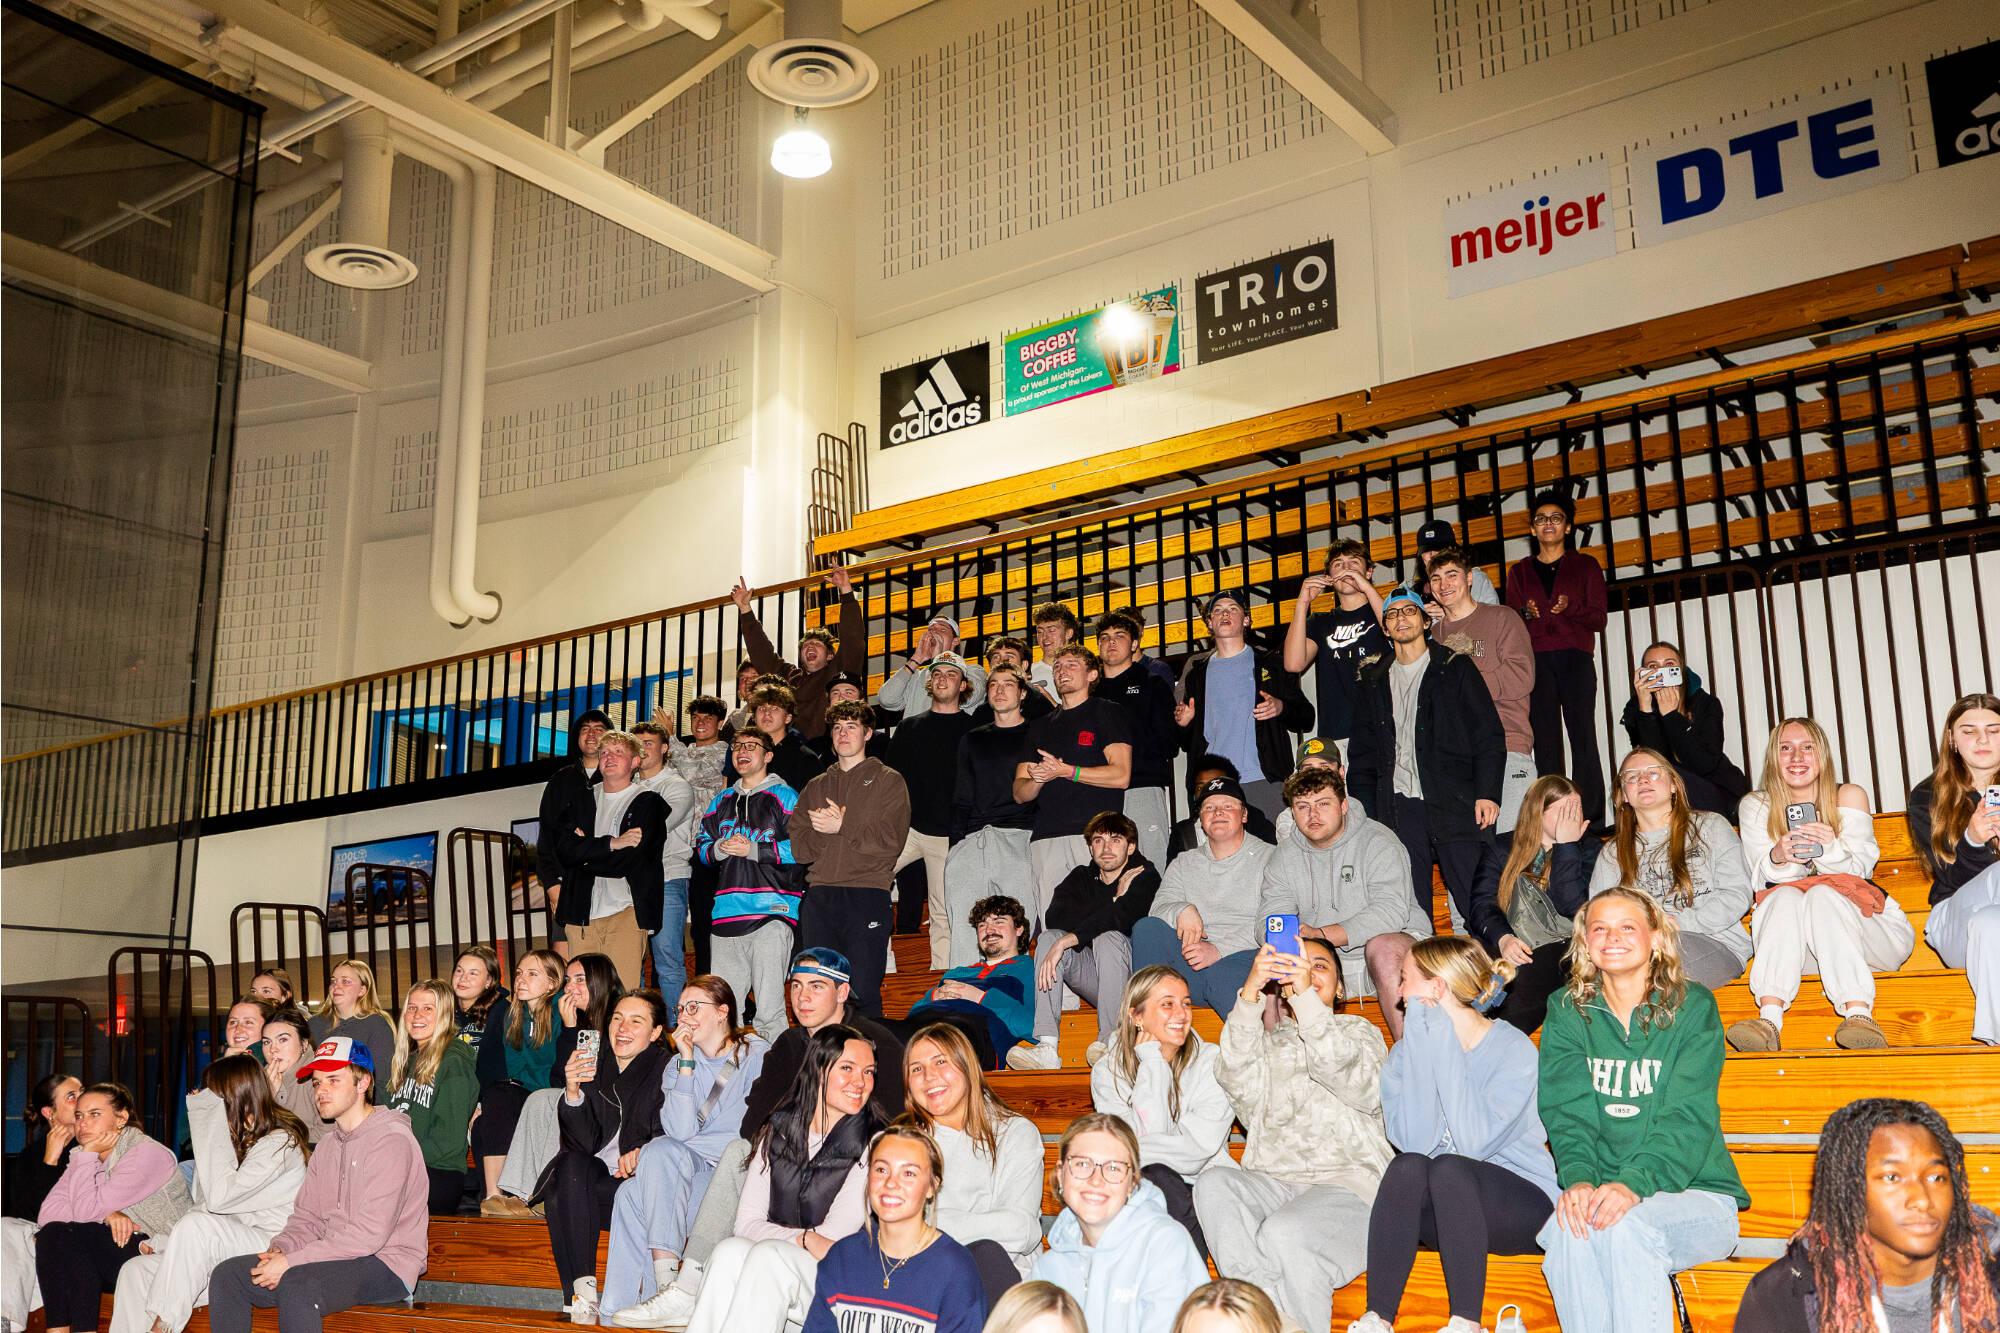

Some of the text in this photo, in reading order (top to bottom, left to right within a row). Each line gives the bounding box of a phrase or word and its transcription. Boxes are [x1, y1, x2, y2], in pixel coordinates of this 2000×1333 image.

[1656, 98, 1880, 225] DTE
[1451, 192, 1605, 268] meijer
[1205, 255, 1328, 317] TRIO
[1208, 299, 1329, 339] townhomes
[1246, 335, 1262, 343] Your
[1289, 323, 1305, 332] Your
[1020, 328, 1078, 362] BIGGBY
[1023, 347, 1077, 378] COFFEE
[1013, 393, 1033, 408] proud
[1033, 385, 1059, 401] sponsor
[1059, 379, 1068, 390] of
[1068, 377, 1080, 388] the
[1080, 370, 1103, 383] Lakers
[1020, 366, 1088, 393] Of West Michigan-
[889, 402, 981, 444] adidas
[1333, 621, 1365, 639] NIKE
[1334, 648, 1365, 659] AIR
[1587, 1057, 1626, 1097] HI
[841, 1309, 876, 1333] OUT
